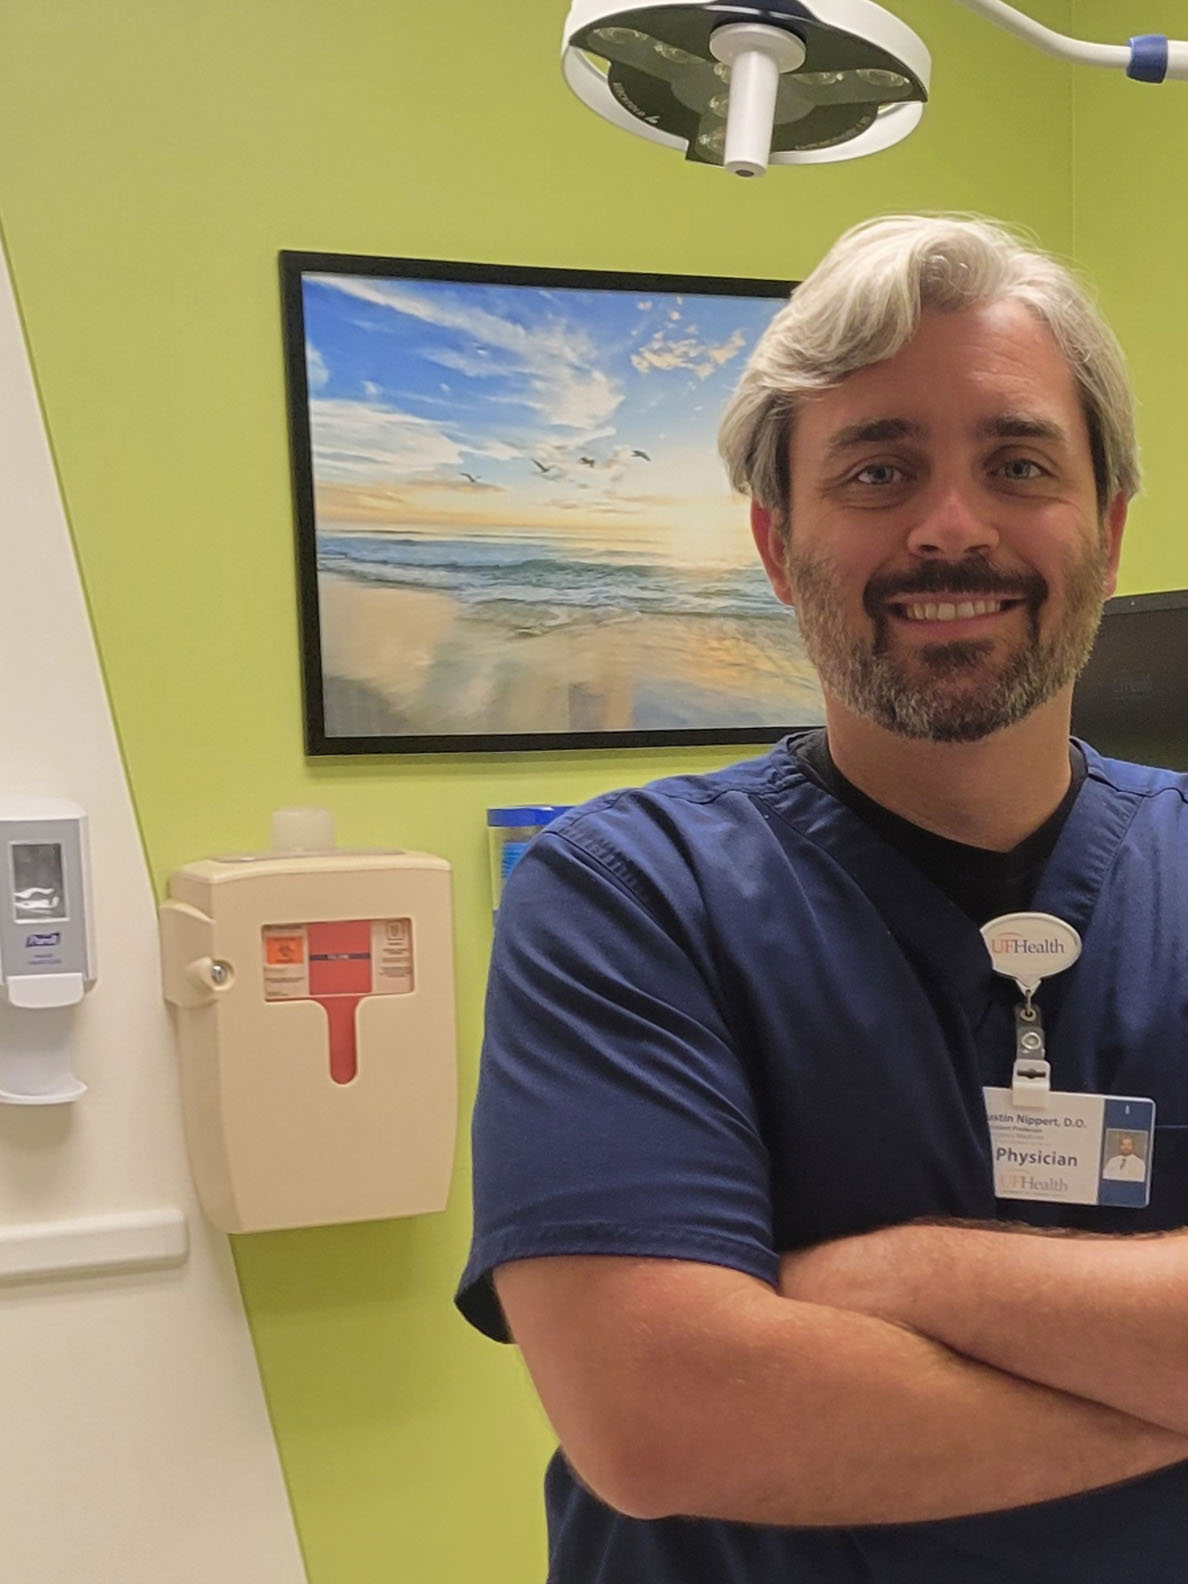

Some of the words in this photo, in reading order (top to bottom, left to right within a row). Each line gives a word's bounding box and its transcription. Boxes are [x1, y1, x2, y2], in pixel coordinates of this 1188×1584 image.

[1016, 1113, 1061, 1127] Nippert,
[1064, 1117, 1087, 1129] D.O.
[996, 1147, 1078, 1167] Physician
